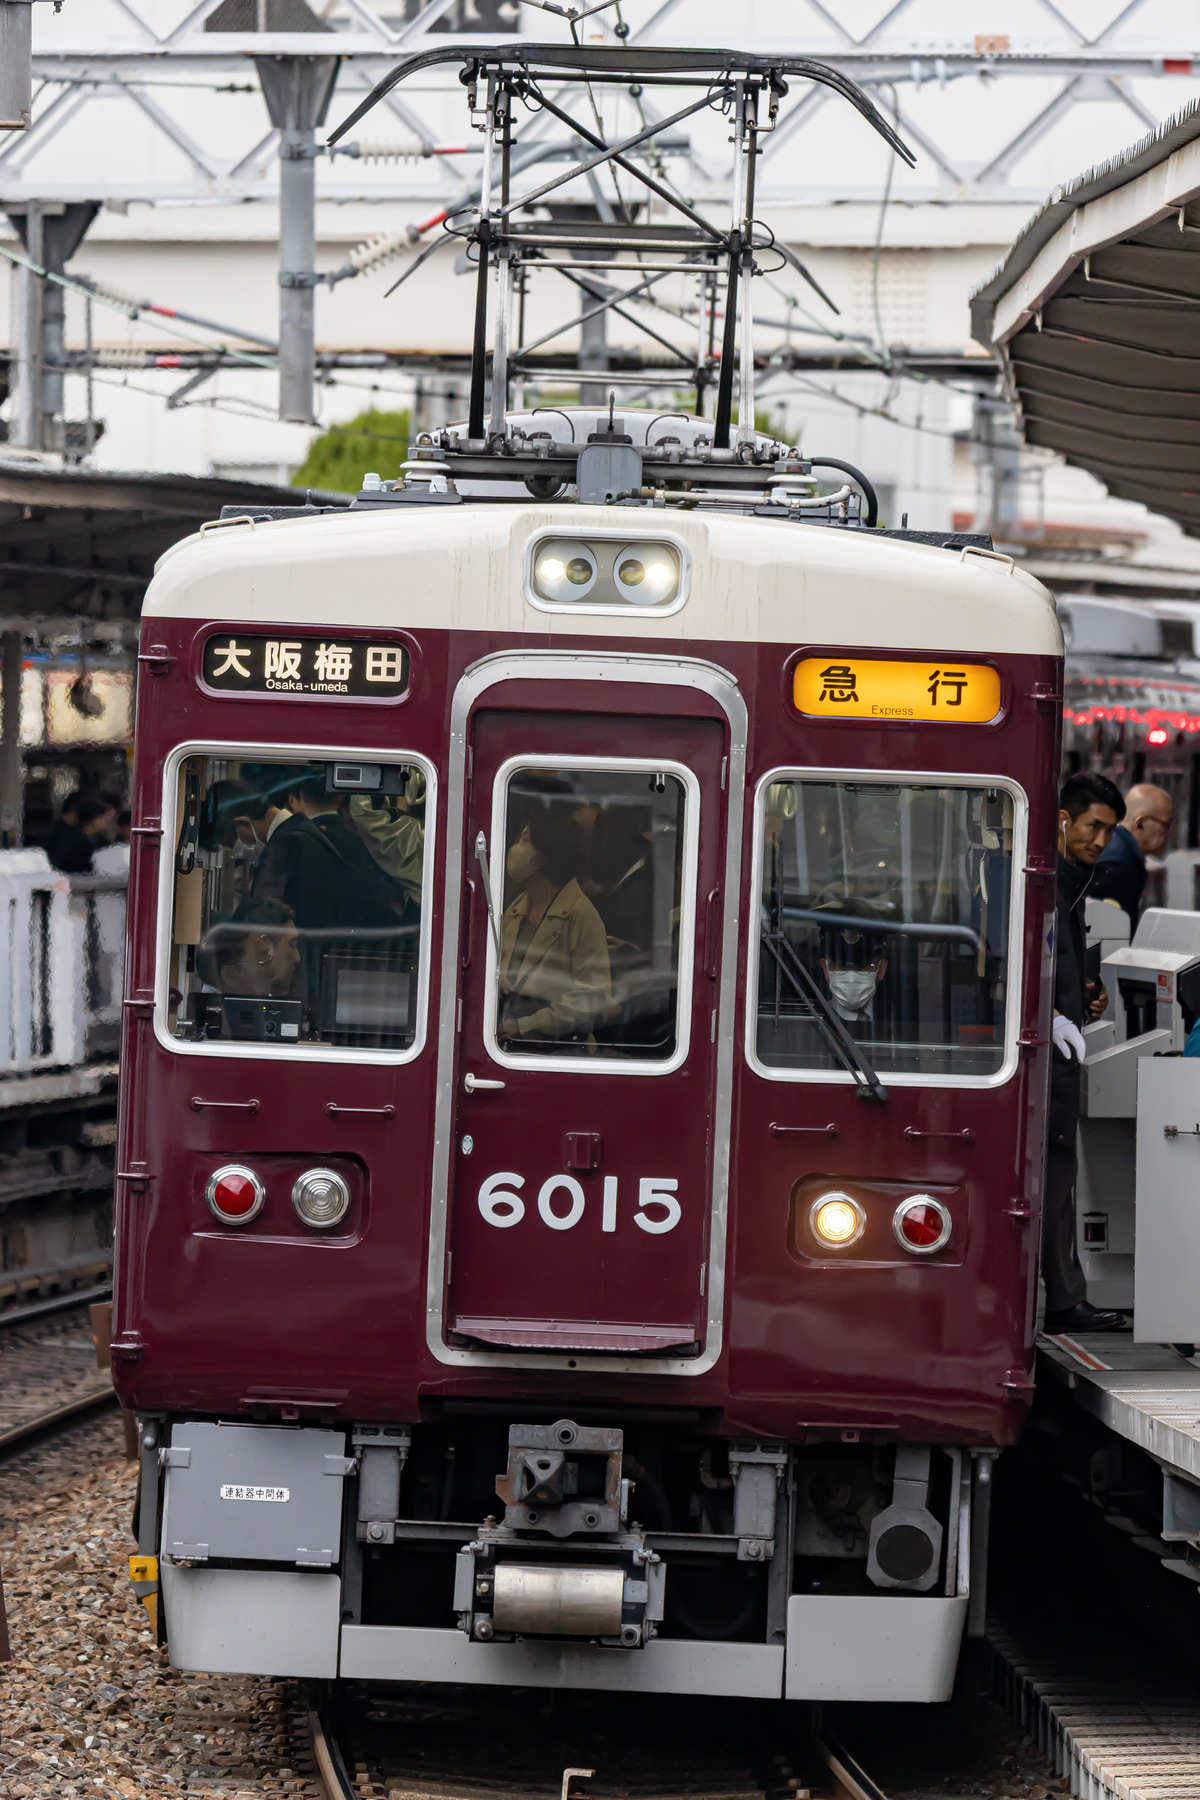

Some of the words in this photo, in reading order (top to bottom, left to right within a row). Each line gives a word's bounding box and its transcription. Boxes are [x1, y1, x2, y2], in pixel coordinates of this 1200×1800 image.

[212, 639, 402, 682] 大阪梅田
[266, 679, 348, 692] Osaka-umeda
[871, 705, 914, 716] Express
[478, 1172, 682, 1234] 6015
[225, 1486, 285, 1500] 連結器中間体
